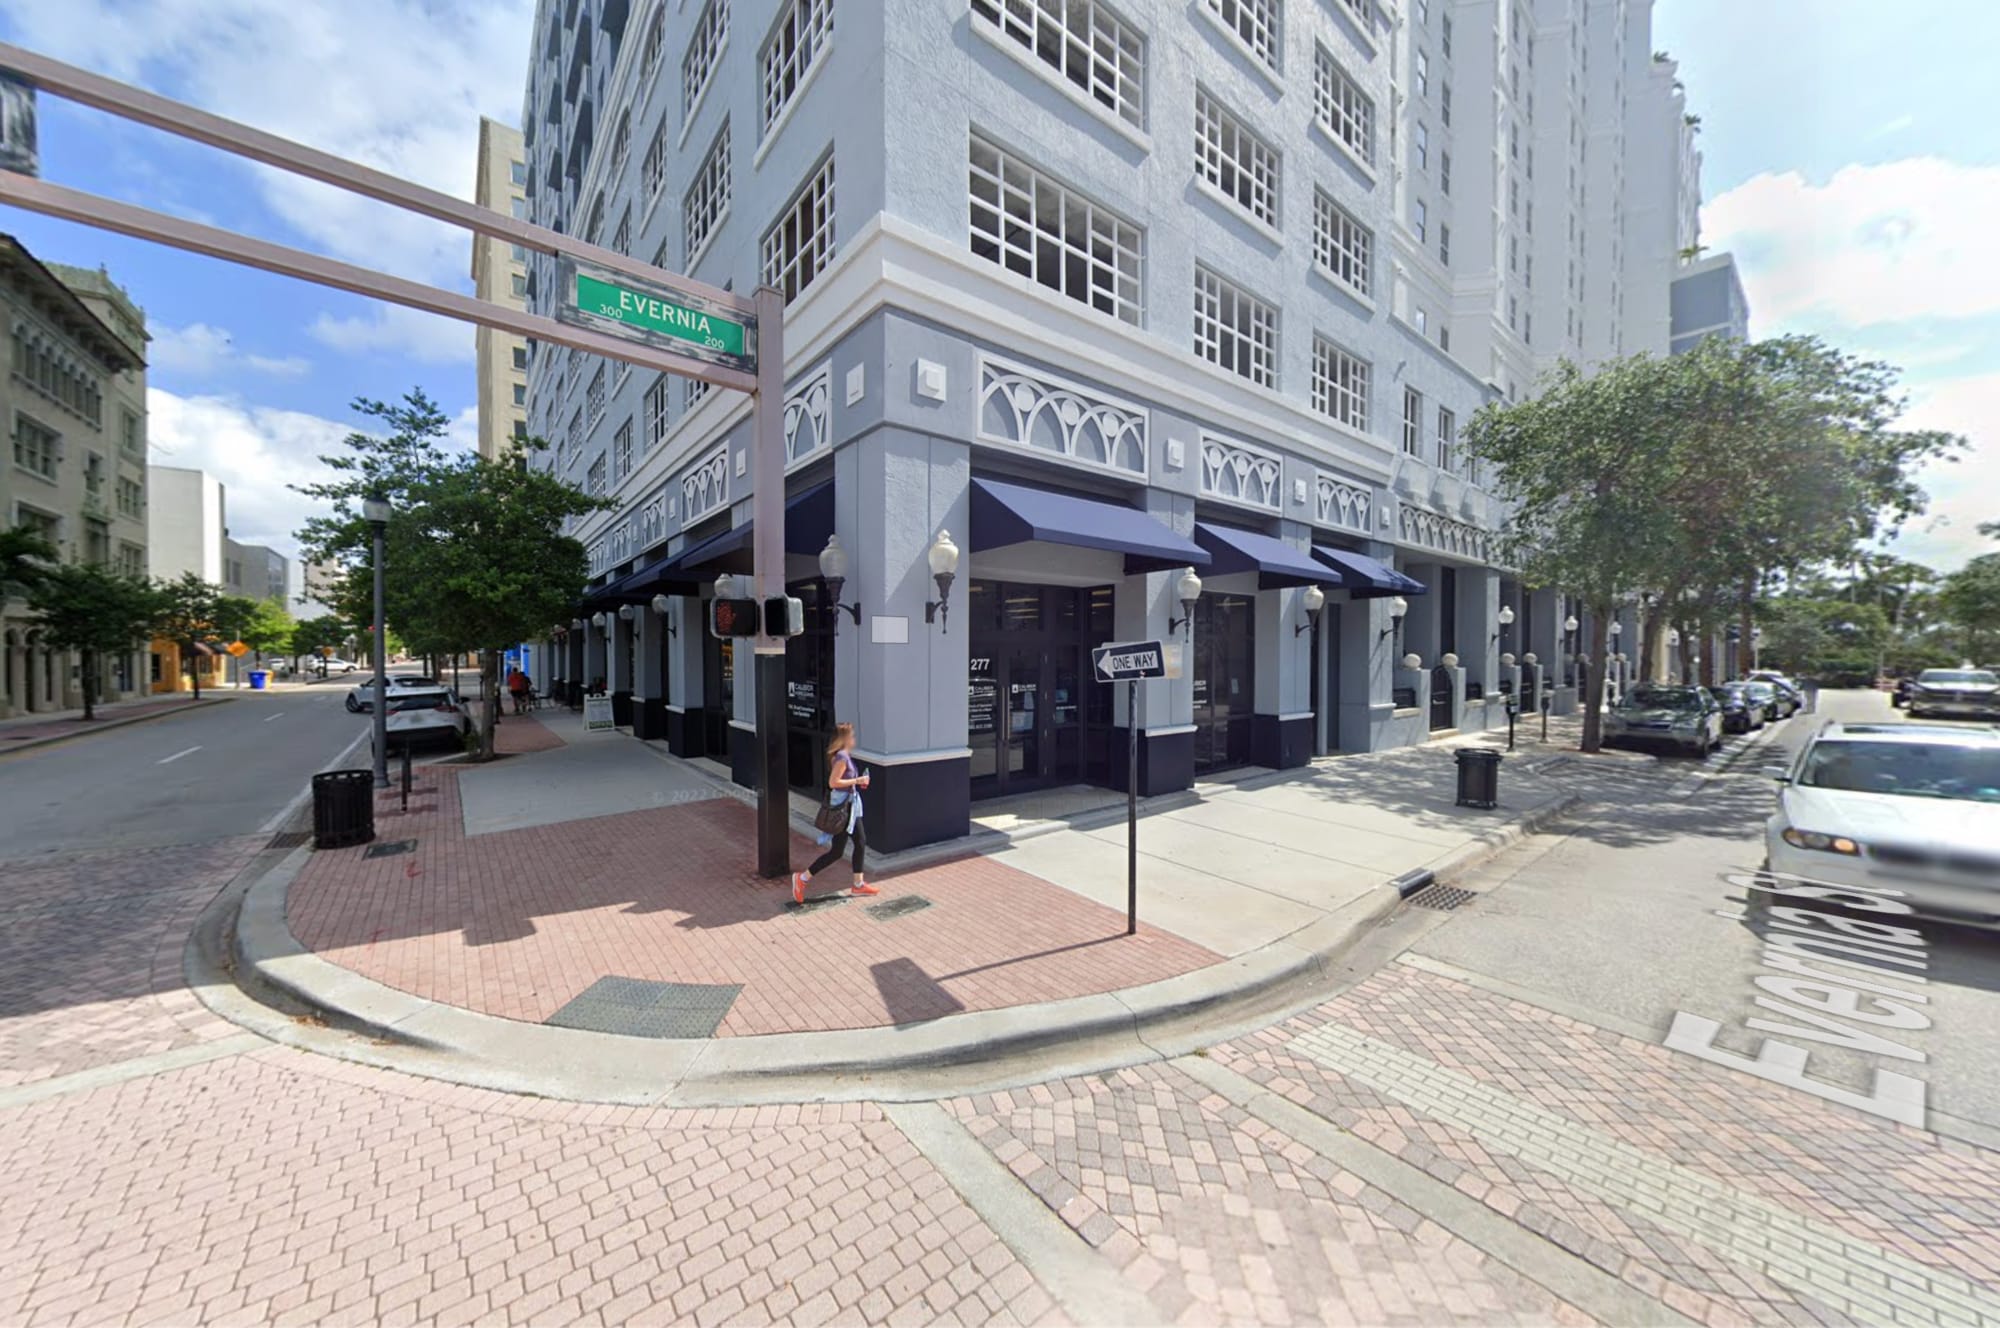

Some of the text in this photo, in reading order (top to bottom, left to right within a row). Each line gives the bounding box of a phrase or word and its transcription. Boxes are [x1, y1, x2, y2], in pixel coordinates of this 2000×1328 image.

[600, 304, 623, 319] 300
[620, 291, 711, 335] EVERNIA
[705, 336, 725, 350] 200
[970, 658, 990, 671] 277
[1112, 653, 1155, 670] ONE WAY
